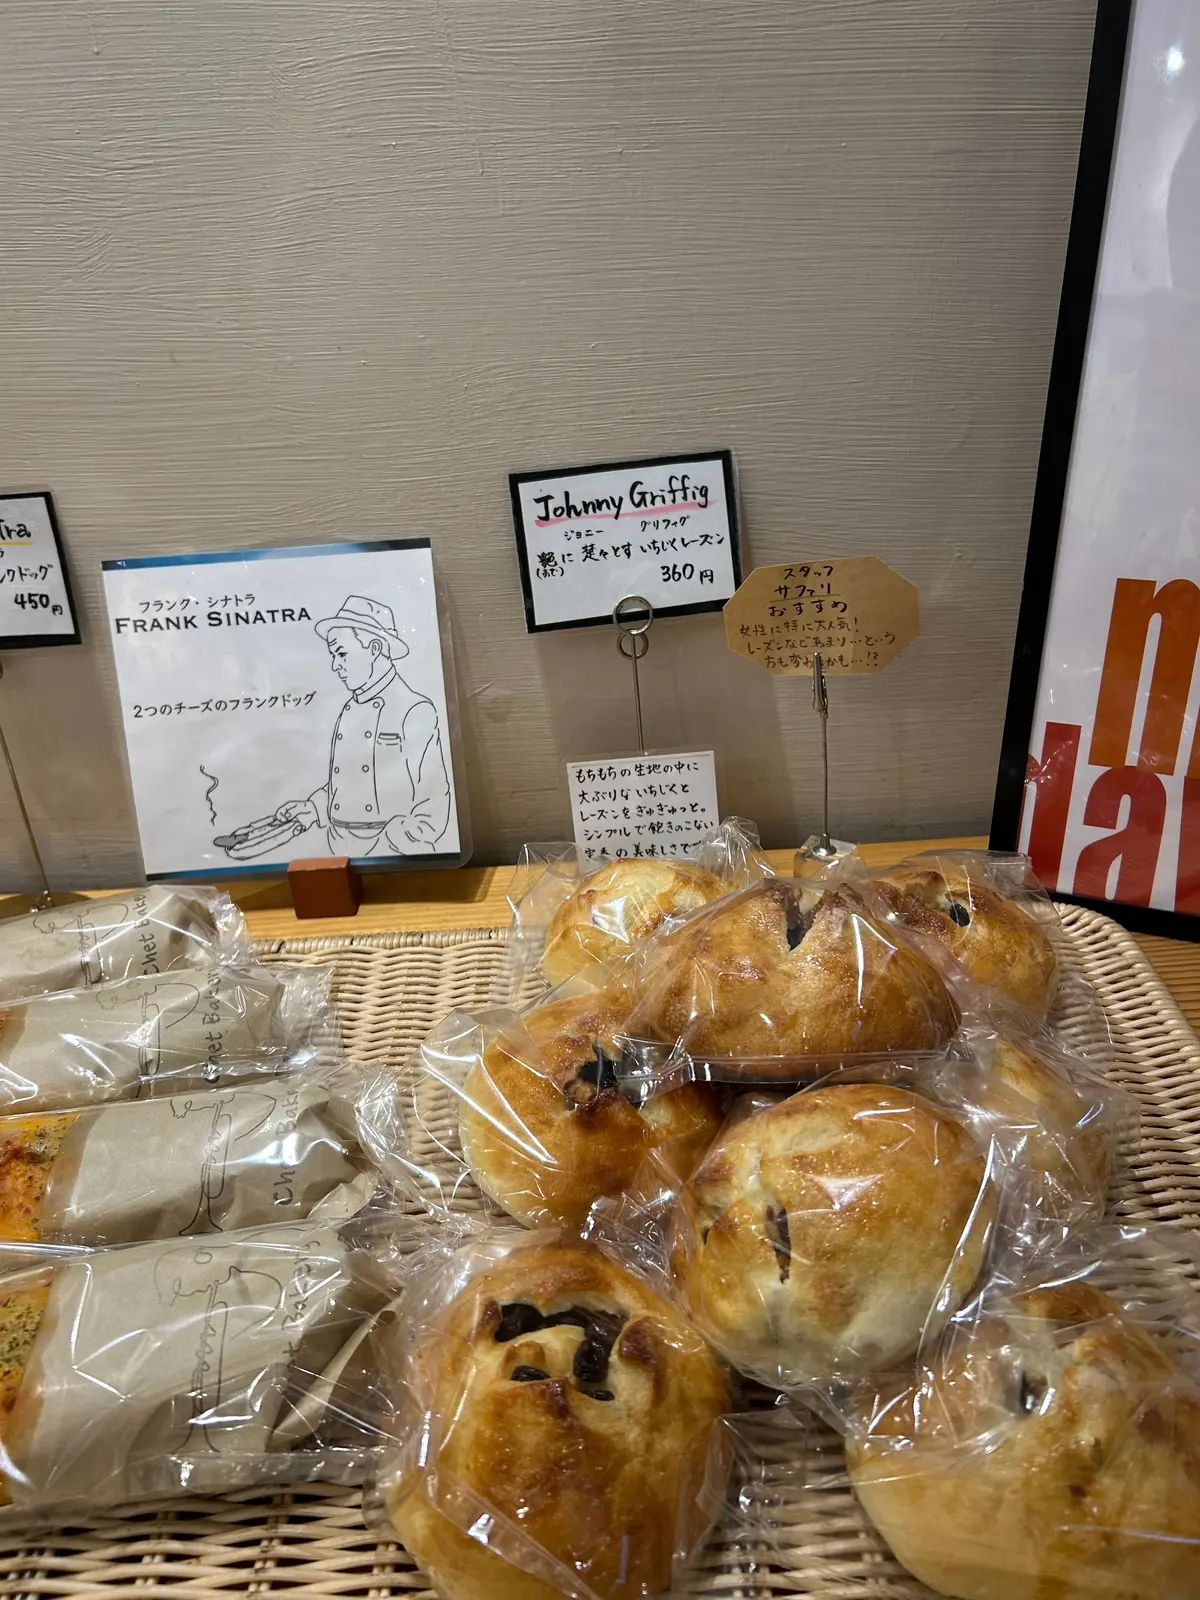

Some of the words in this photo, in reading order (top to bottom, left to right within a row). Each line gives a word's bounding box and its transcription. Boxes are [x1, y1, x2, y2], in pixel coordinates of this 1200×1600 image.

[533, 491, 623, 521] Johnny
[629, 475, 709, 508] Griffig
[564, 529, 604, 541] ジョニー
[640, 516, 690, 532] グリフィグ
[783, 565, 834, 580] スタッフ
[115, 615, 198, 634] FRANK
[207, 607, 312, 627] SINATRA
[768, 599, 848, 617] おすすめ
[133, 690, 317, 718] 2つのチーズのフランクドッグ
[575, 760, 699, 783] もちもちの生地の中に
